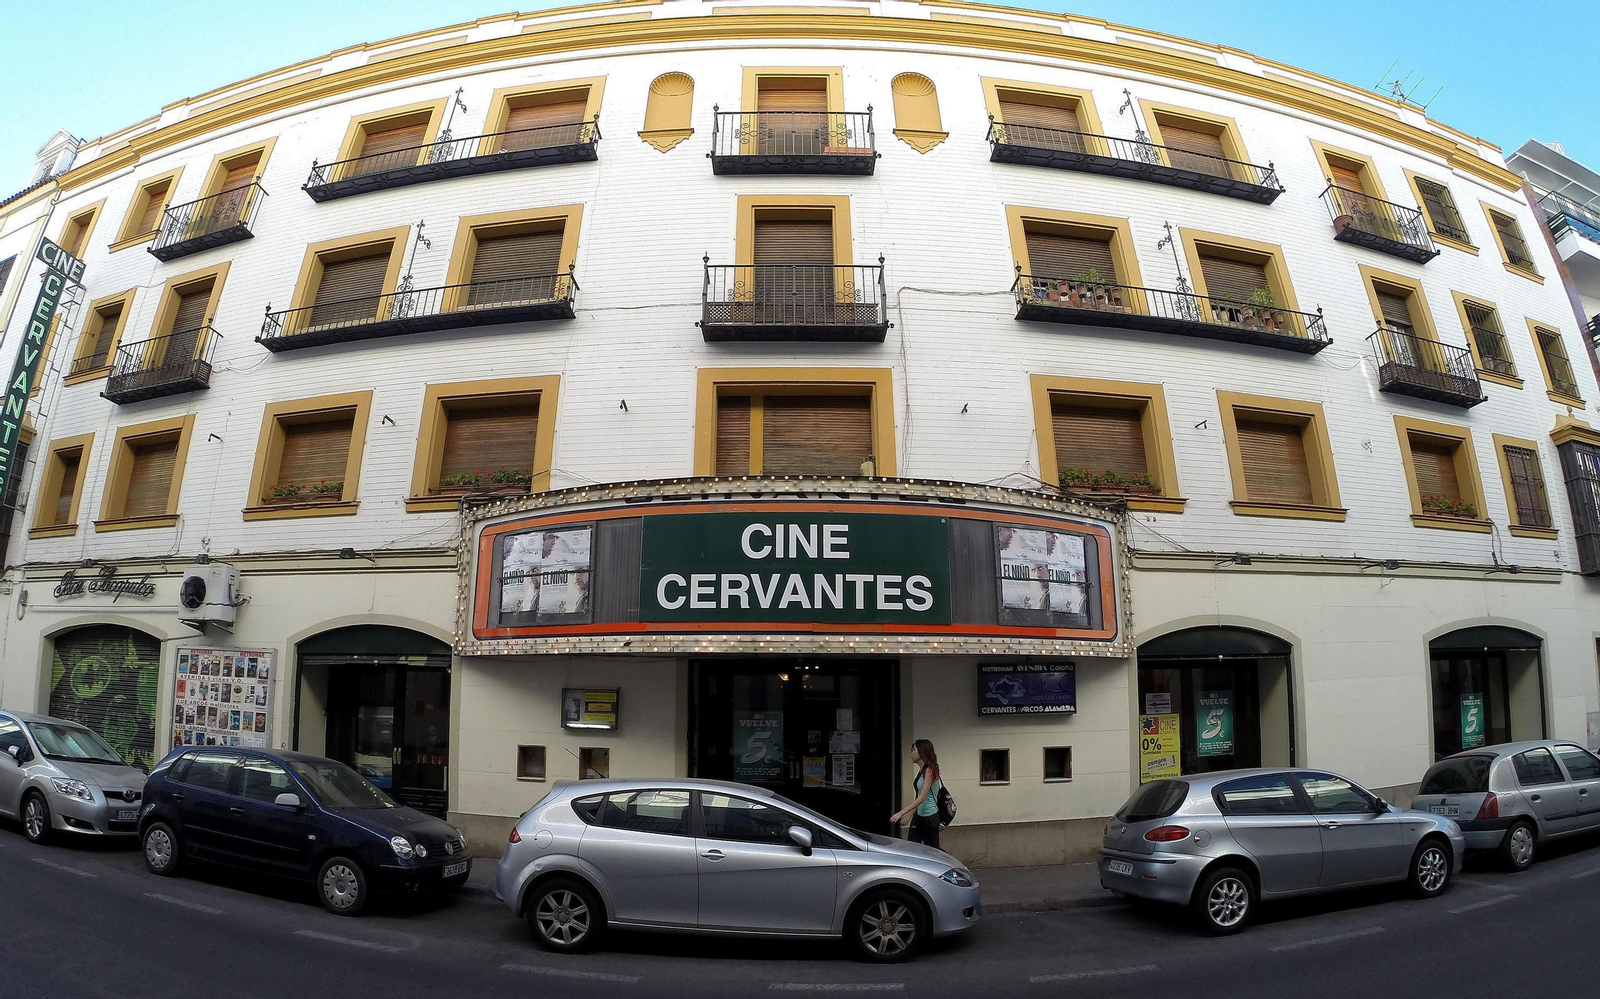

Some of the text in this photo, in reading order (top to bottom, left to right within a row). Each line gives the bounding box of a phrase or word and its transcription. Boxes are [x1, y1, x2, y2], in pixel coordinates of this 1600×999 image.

[42, 243, 84, 282] CINE
[741, 523, 850, 559] CINE
[656, 573, 934, 612] CERVANTES
[1200, 698, 1229, 706] VUELVE
[981, 706, 1016, 714] CERVANTES
[739, 719, 778, 727] VUELVE
[1160, 720, 1176, 731] CINE
[1142, 737, 1162, 751] 0%
[1147, 757, 1166, 767] compra
